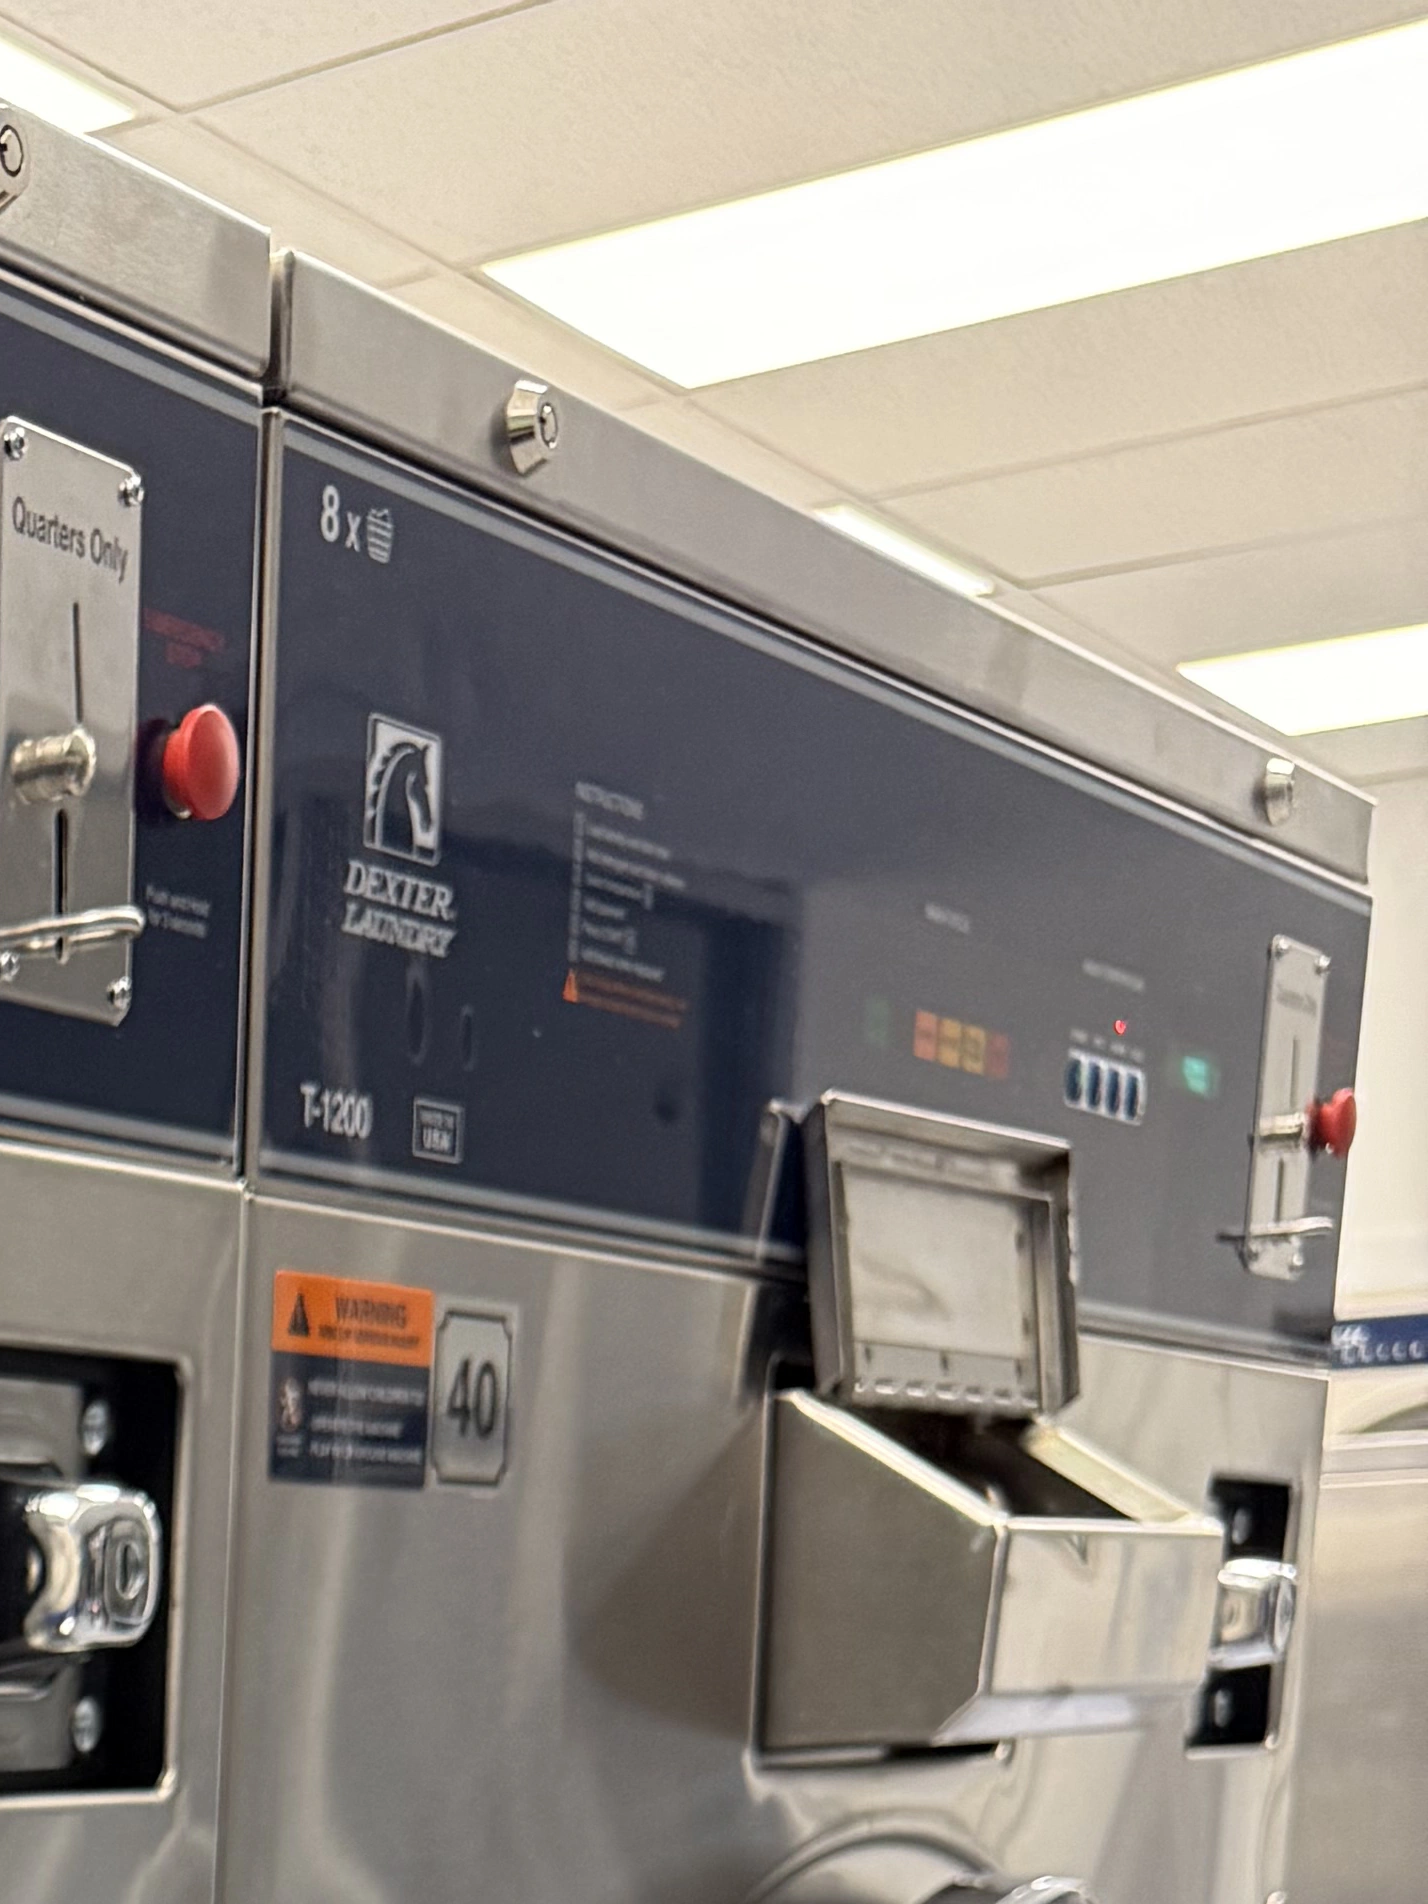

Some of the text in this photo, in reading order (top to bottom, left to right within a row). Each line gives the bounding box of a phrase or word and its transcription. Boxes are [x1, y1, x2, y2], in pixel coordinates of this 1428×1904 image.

[12, 496, 128, 584] Quarters Only
[321, 485, 361, 552] 8 x
[343, 860, 454, 921] DEXTER
[341, 901, 458, 958] LAUNDRY
[300, 1080, 374, 1140] T-1200
[336, 1296, 406, 1330] WARNING
[447, 1357, 500, 1440] 40
